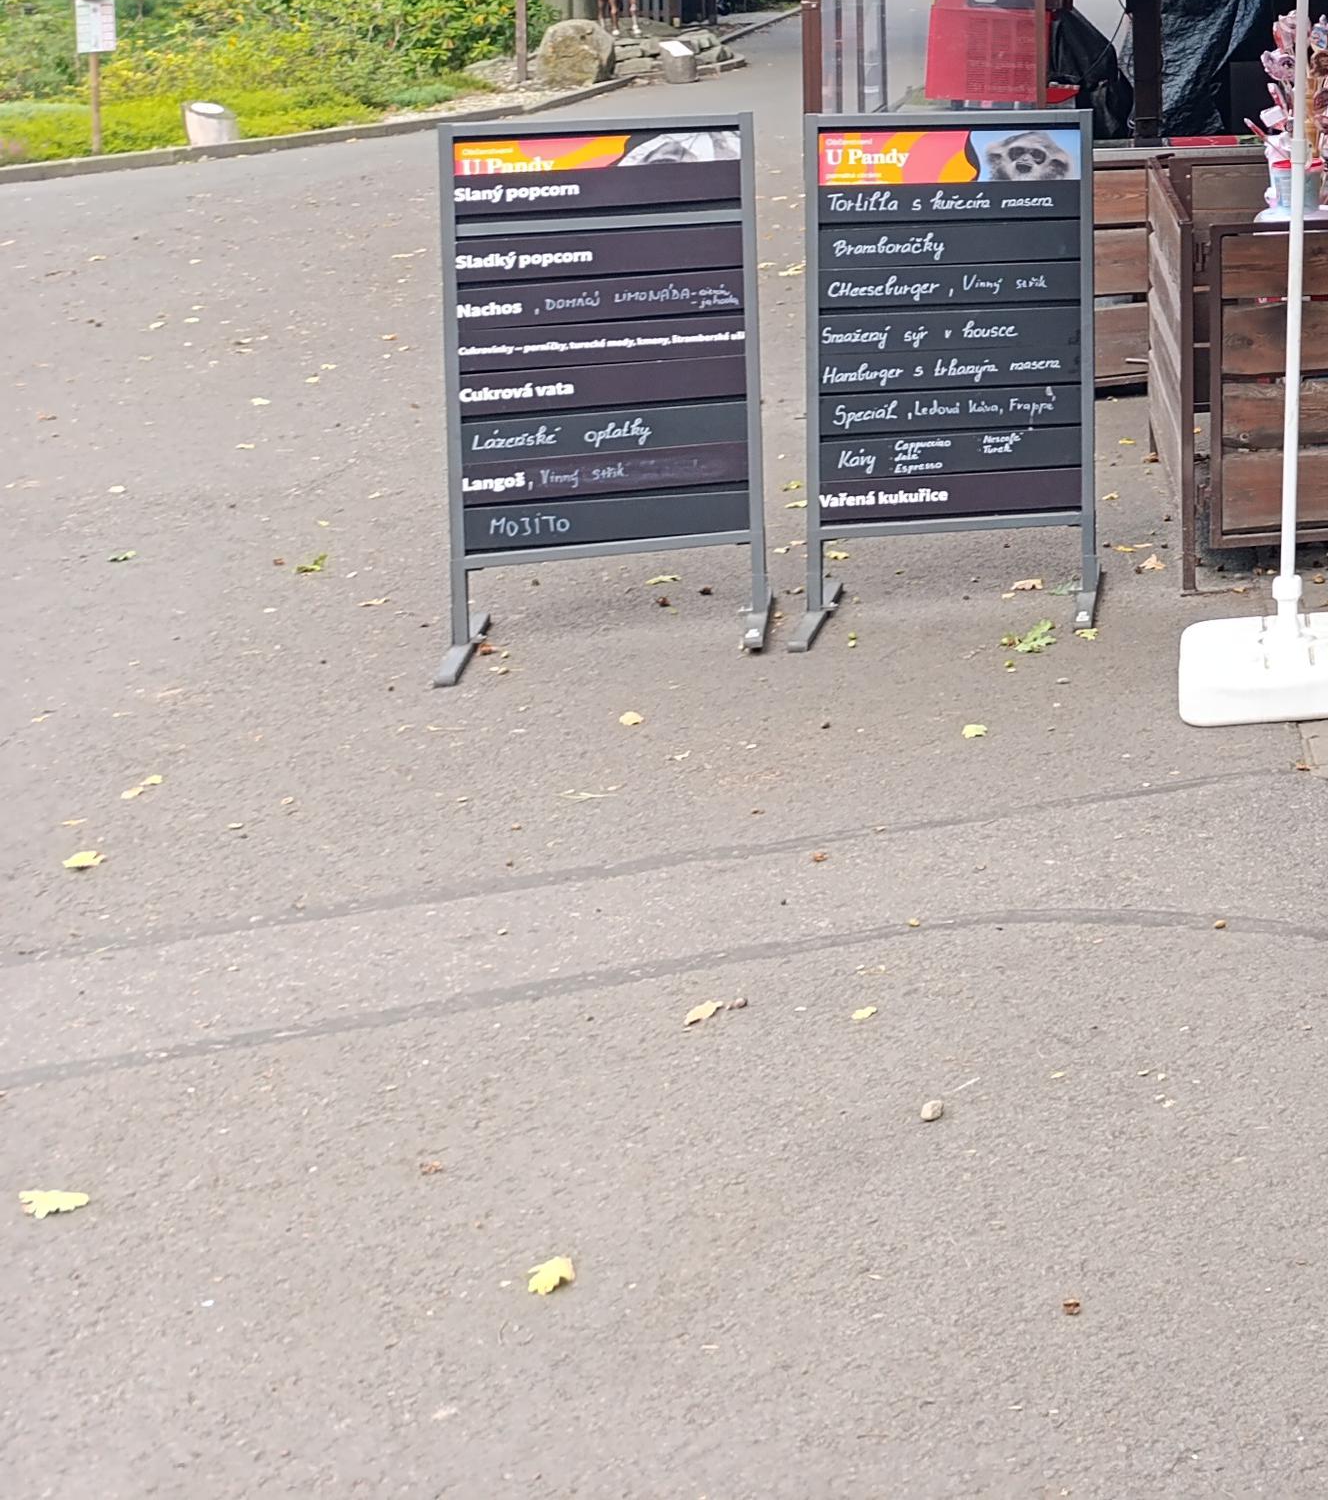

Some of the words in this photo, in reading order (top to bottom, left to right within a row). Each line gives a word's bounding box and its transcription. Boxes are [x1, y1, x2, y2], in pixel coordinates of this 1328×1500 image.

[462, 159, 481, 176] U
[486, 156, 555, 175] Pandy
[825, 149, 843, 165] U
[848, 147, 910, 167] Pandy
[454, 185, 502, 202] Slaný
[506, 184, 580, 202] popcorn
[827, 190, 898, 212] Tortilla
[911, 199, 922, 210] s
[832, 233, 944, 260] Bramboráčky
[455, 252, 515, 270] Sladký
[519, 250, 593, 269] popcorn
[457, 299, 522, 318] Nachos
[821, 326, 891, 349] Smažený
[904, 326, 928, 348] sýr
[944, 329, 952, 339] v
[962, 320, 1018, 338] housce
[823, 363, 903, 386] Hamburger
[913, 366, 924, 377] s
[934, 359, 998, 382] trhaným
[459, 382, 533, 402] Cukrová
[536, 382, 575, 397] vata
[584, 417, 652, 446] oplatky
[838, 450, 876, 474] Kávy
[894, 462, 943, 474] Espresso
[462, 472, 525, 492] Langoš
[819, 490, 875, 508] Vařená
[878, 488, 948, 506] kukuřice
